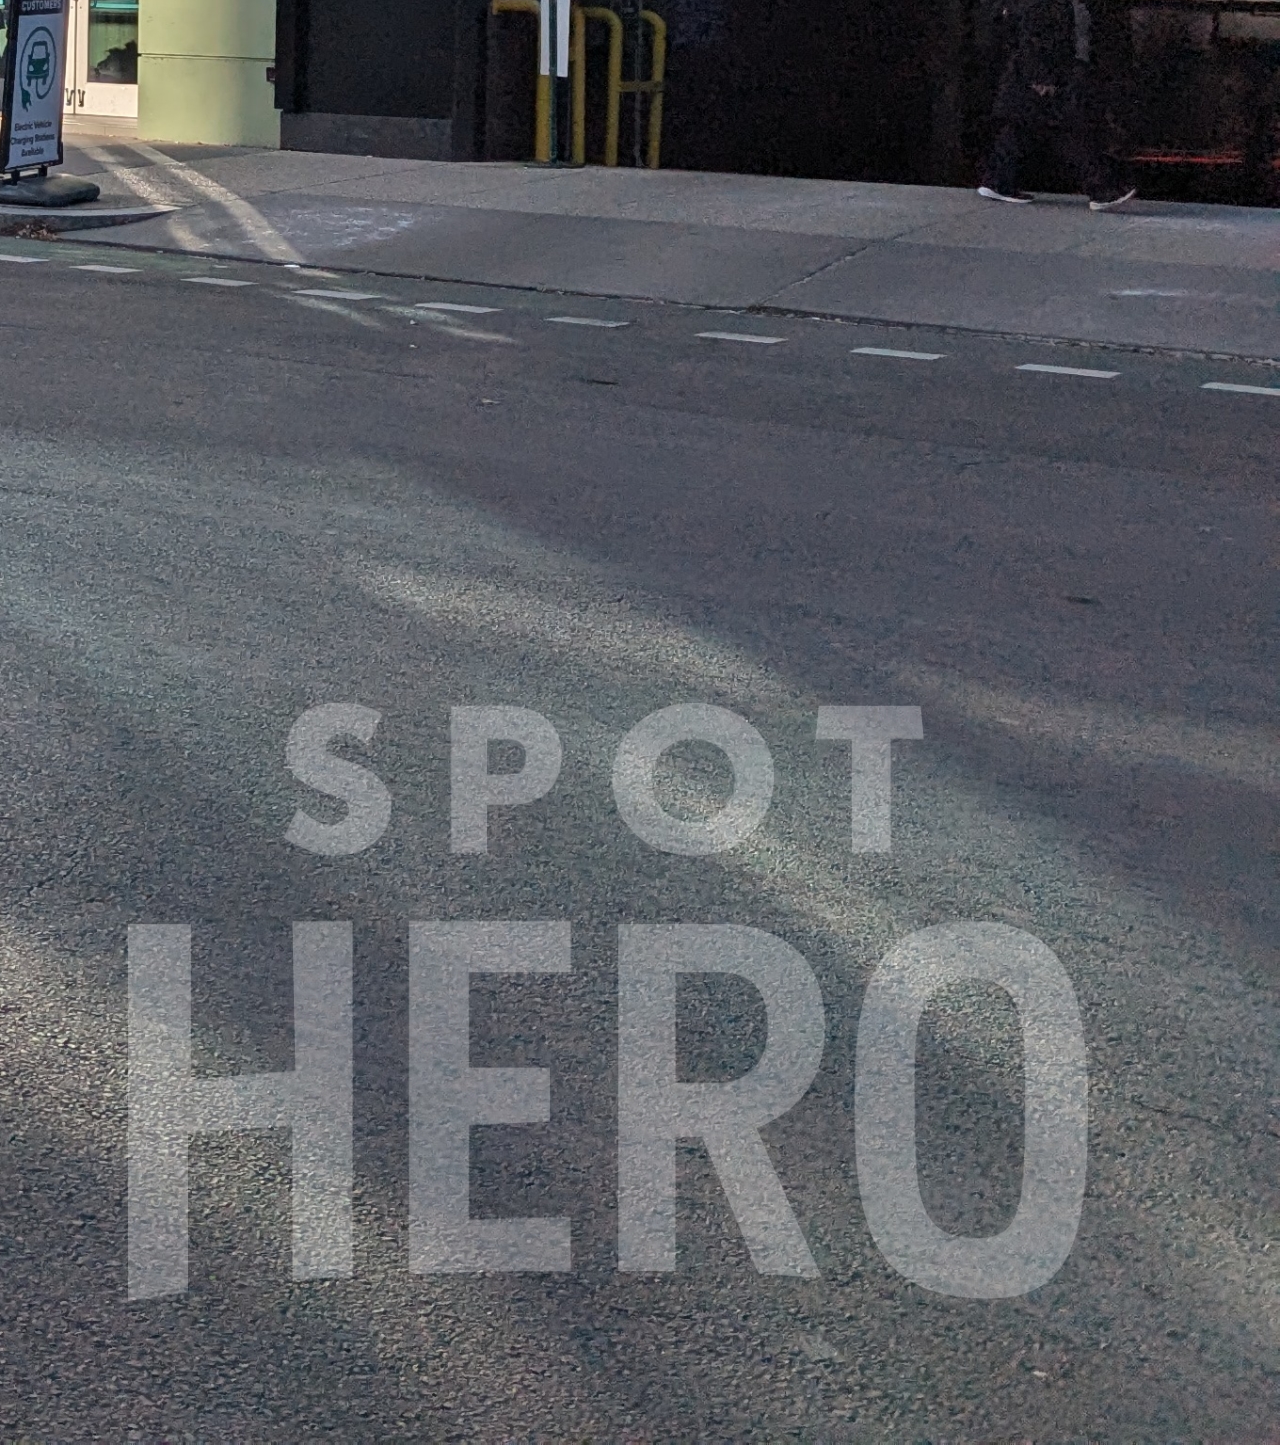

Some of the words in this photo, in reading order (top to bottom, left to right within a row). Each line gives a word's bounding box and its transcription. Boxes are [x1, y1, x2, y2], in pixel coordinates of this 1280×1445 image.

[14, 121, 33, 132] Electric
[34, 120, 52, 129] Vehicle
[10, 135, 33, 146] Charging
